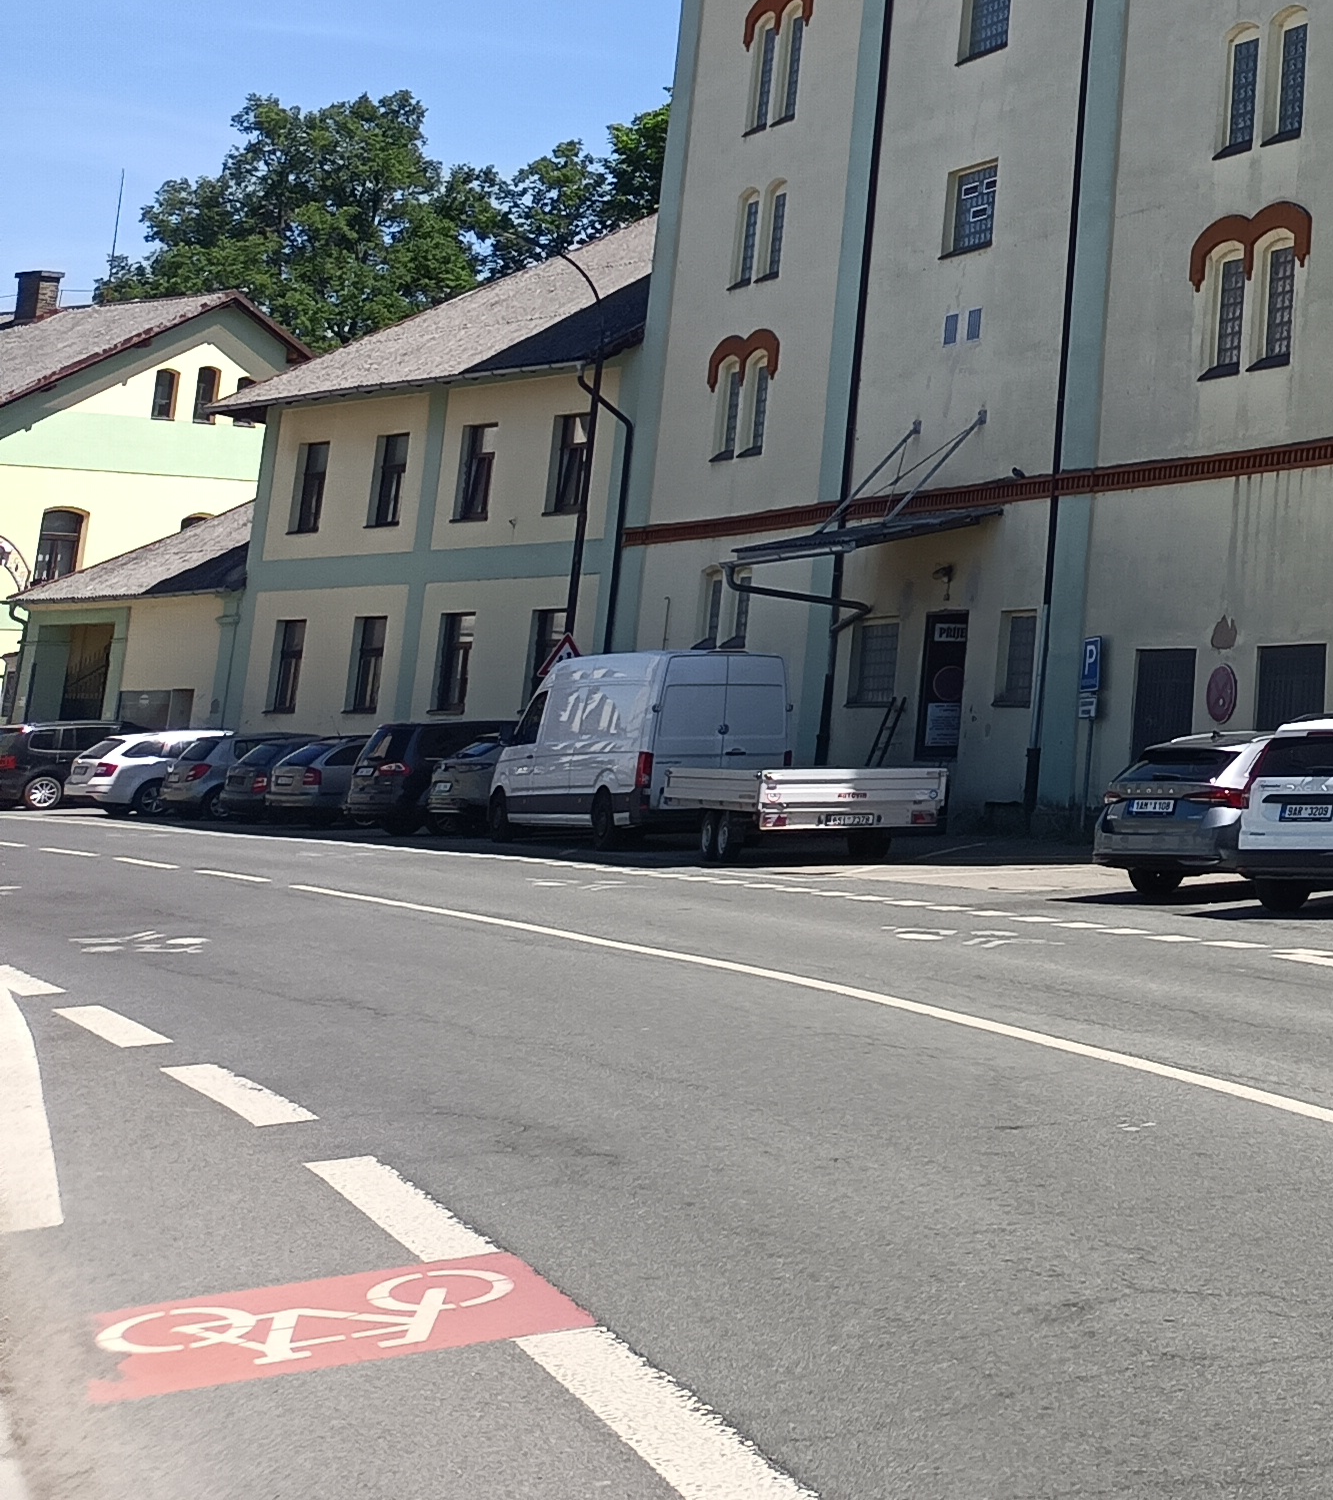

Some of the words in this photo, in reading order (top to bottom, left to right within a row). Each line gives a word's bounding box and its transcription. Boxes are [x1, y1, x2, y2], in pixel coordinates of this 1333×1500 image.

[1084, 644, 1097, 676] P
[1287, 806, 1304, 816] 9AR
[1307, 806, 1330, 816] 3209
